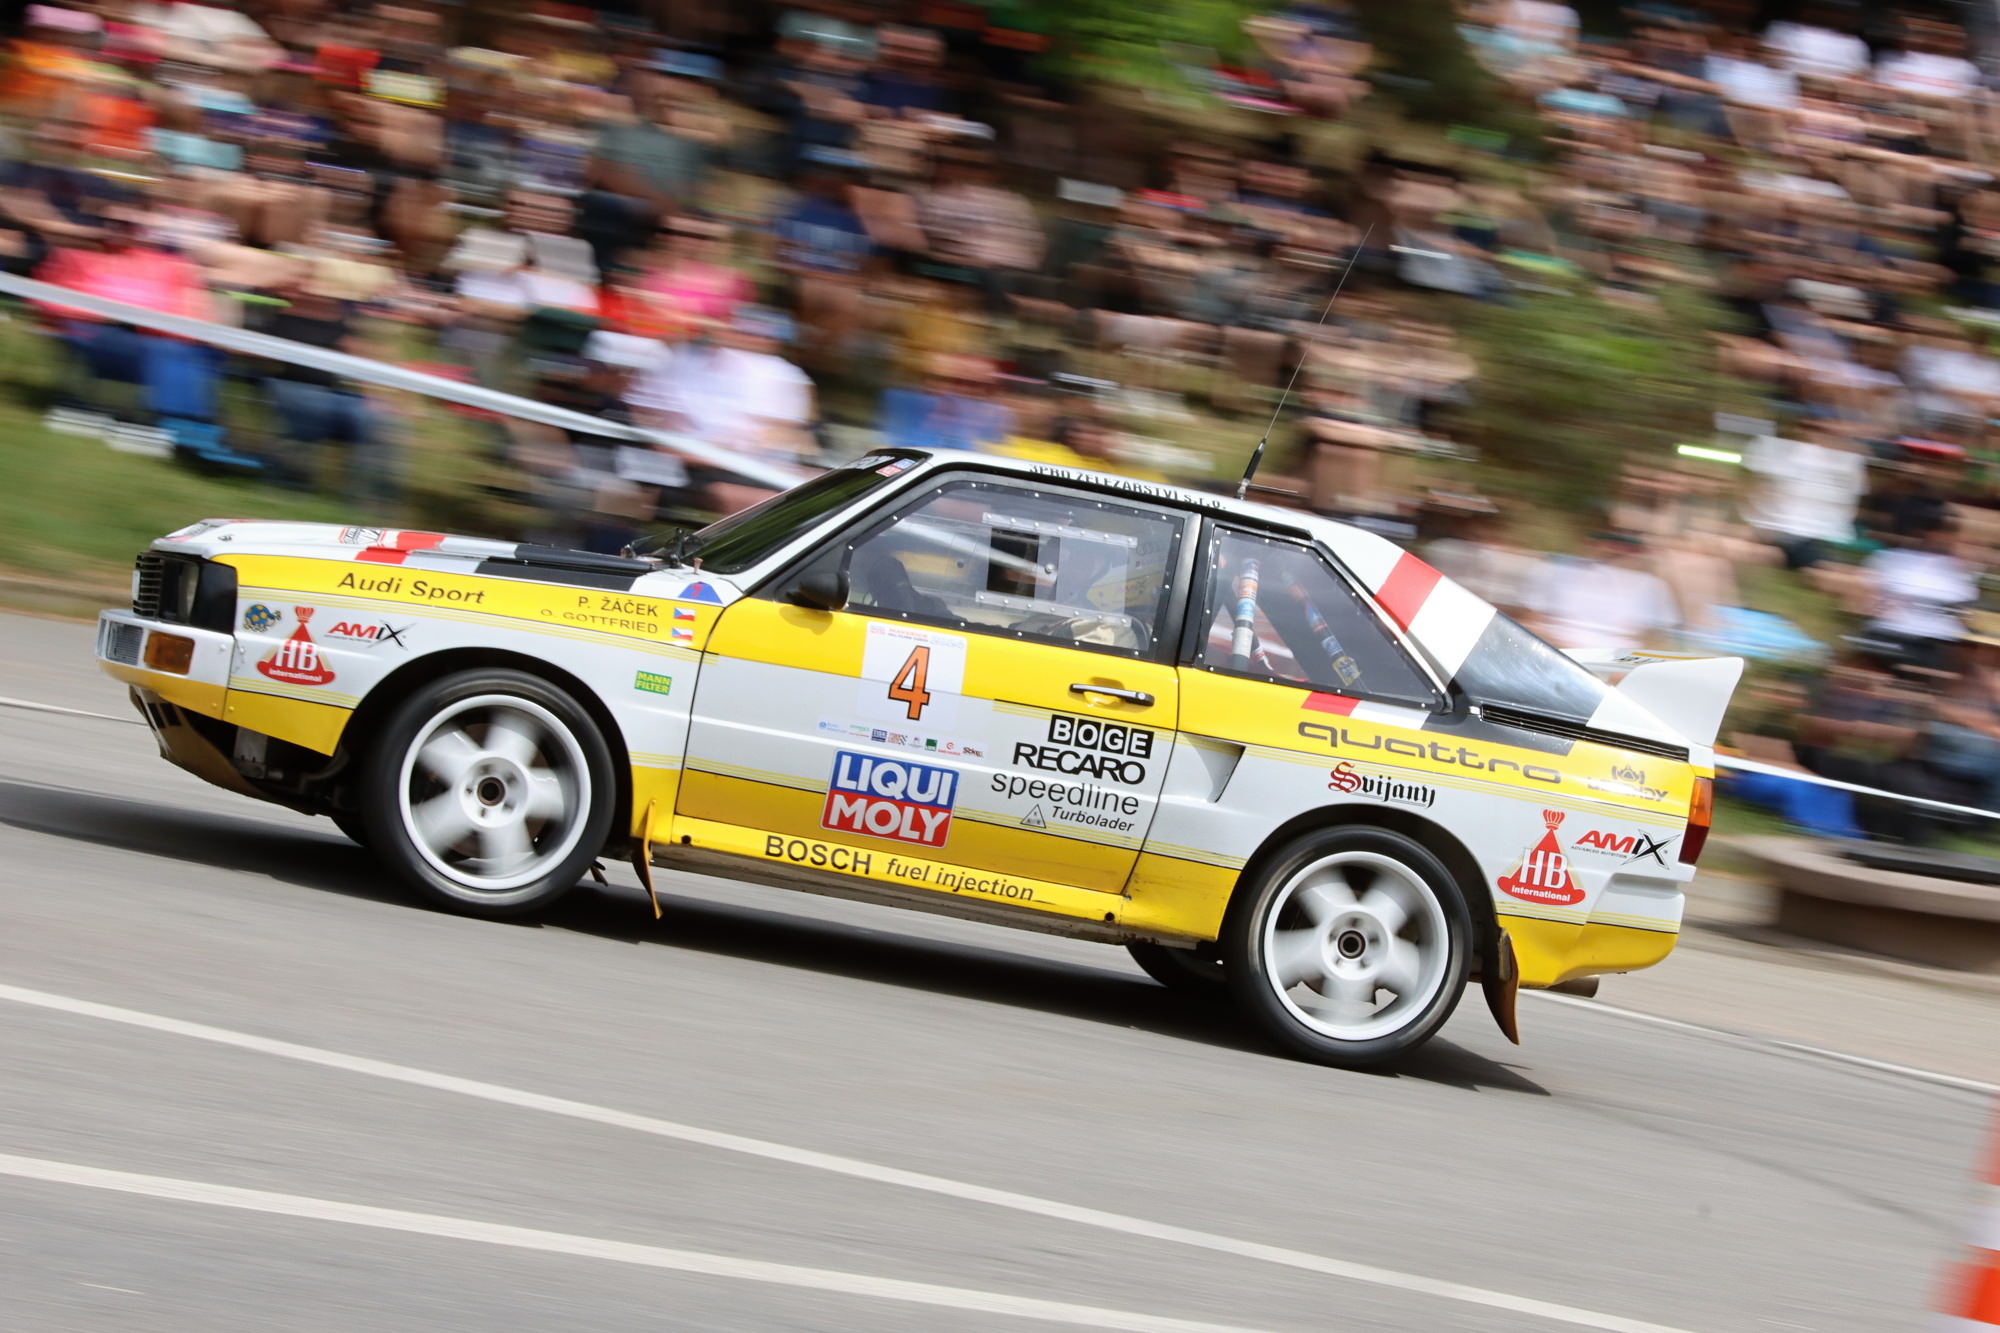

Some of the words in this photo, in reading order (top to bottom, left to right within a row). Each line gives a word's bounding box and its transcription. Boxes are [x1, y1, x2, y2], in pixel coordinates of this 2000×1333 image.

[337, 572, 402, 593] Audi
[410, 580, 485, 604] Sport
[578, 595, 591, 609] P.
[601, 596, 659, 618] ŽÁČEK
[328, 620, 415, 650] AMIX
[563, 611, 658, 634] GOTTFRIED
[275, 639, 319, 672] HB
[888, 645, 931, 721] 4
[1051, 717, 1152, 757] BOGE
[1298, 721, 1562, 784] quattro
[836, 754, 954, 805] LIQUI
[1012, 742, 1146, 785] RECARO
[991, 773, 1139, 815] speedline
[1328, 761, 1436, 808] Svijany
[828, 795, 950, 842] MOLY
[1051, 805, 1135, 832] Turbolader
[765, 835, 872, 875] BOSCH
[885, 858, 928, 881] fuel
[935, 867, 1034, 901] injection
[1518, 850, 1568, 889] HB
[1576, 829, 1680, 870] AMIX
[1511, 884, 1571, 902] international
